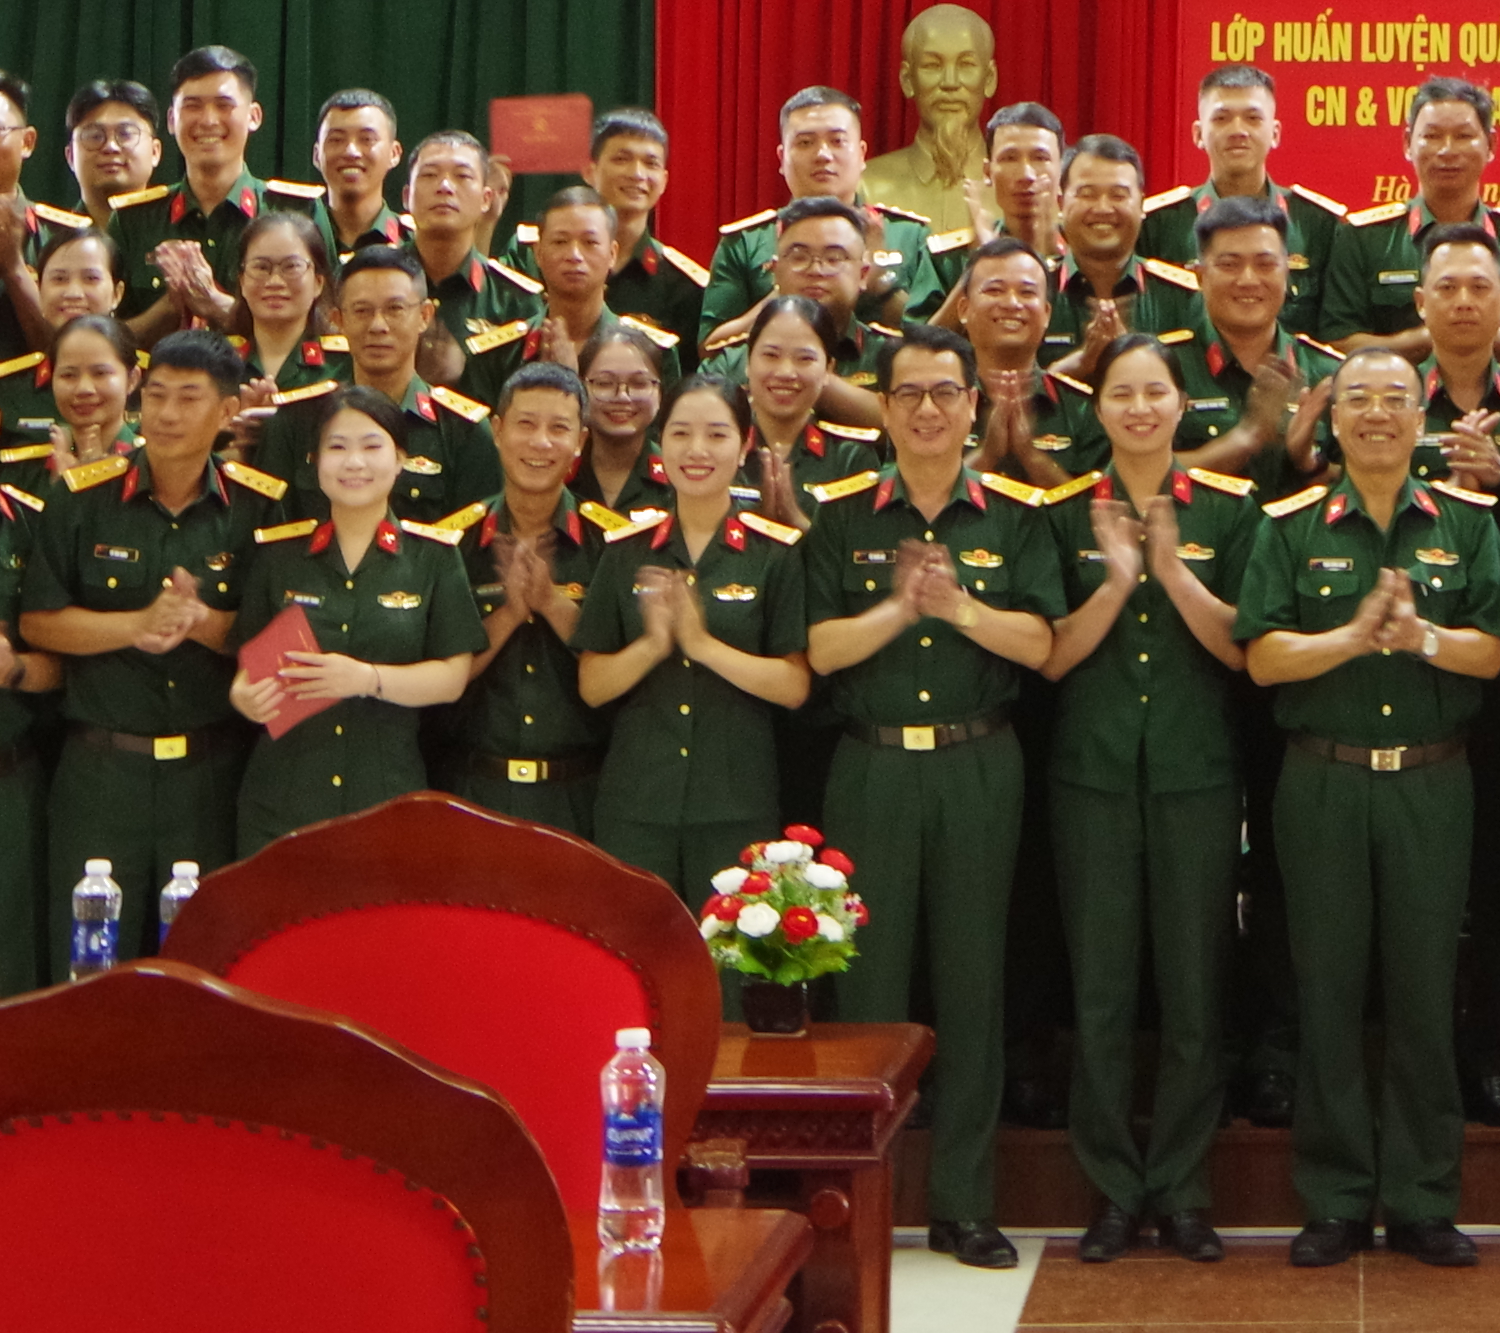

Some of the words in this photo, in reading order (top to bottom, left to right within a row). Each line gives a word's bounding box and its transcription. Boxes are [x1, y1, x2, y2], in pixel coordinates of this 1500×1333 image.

[1212, 14, 1265, 62] LỚP
[1274, 9, 1352, 62] HUẤN
[1361, 15, 1450, 71] LUYỆN
[1307, 86, 1346, 126] CN
[1356, 87, 1377, 126] &
